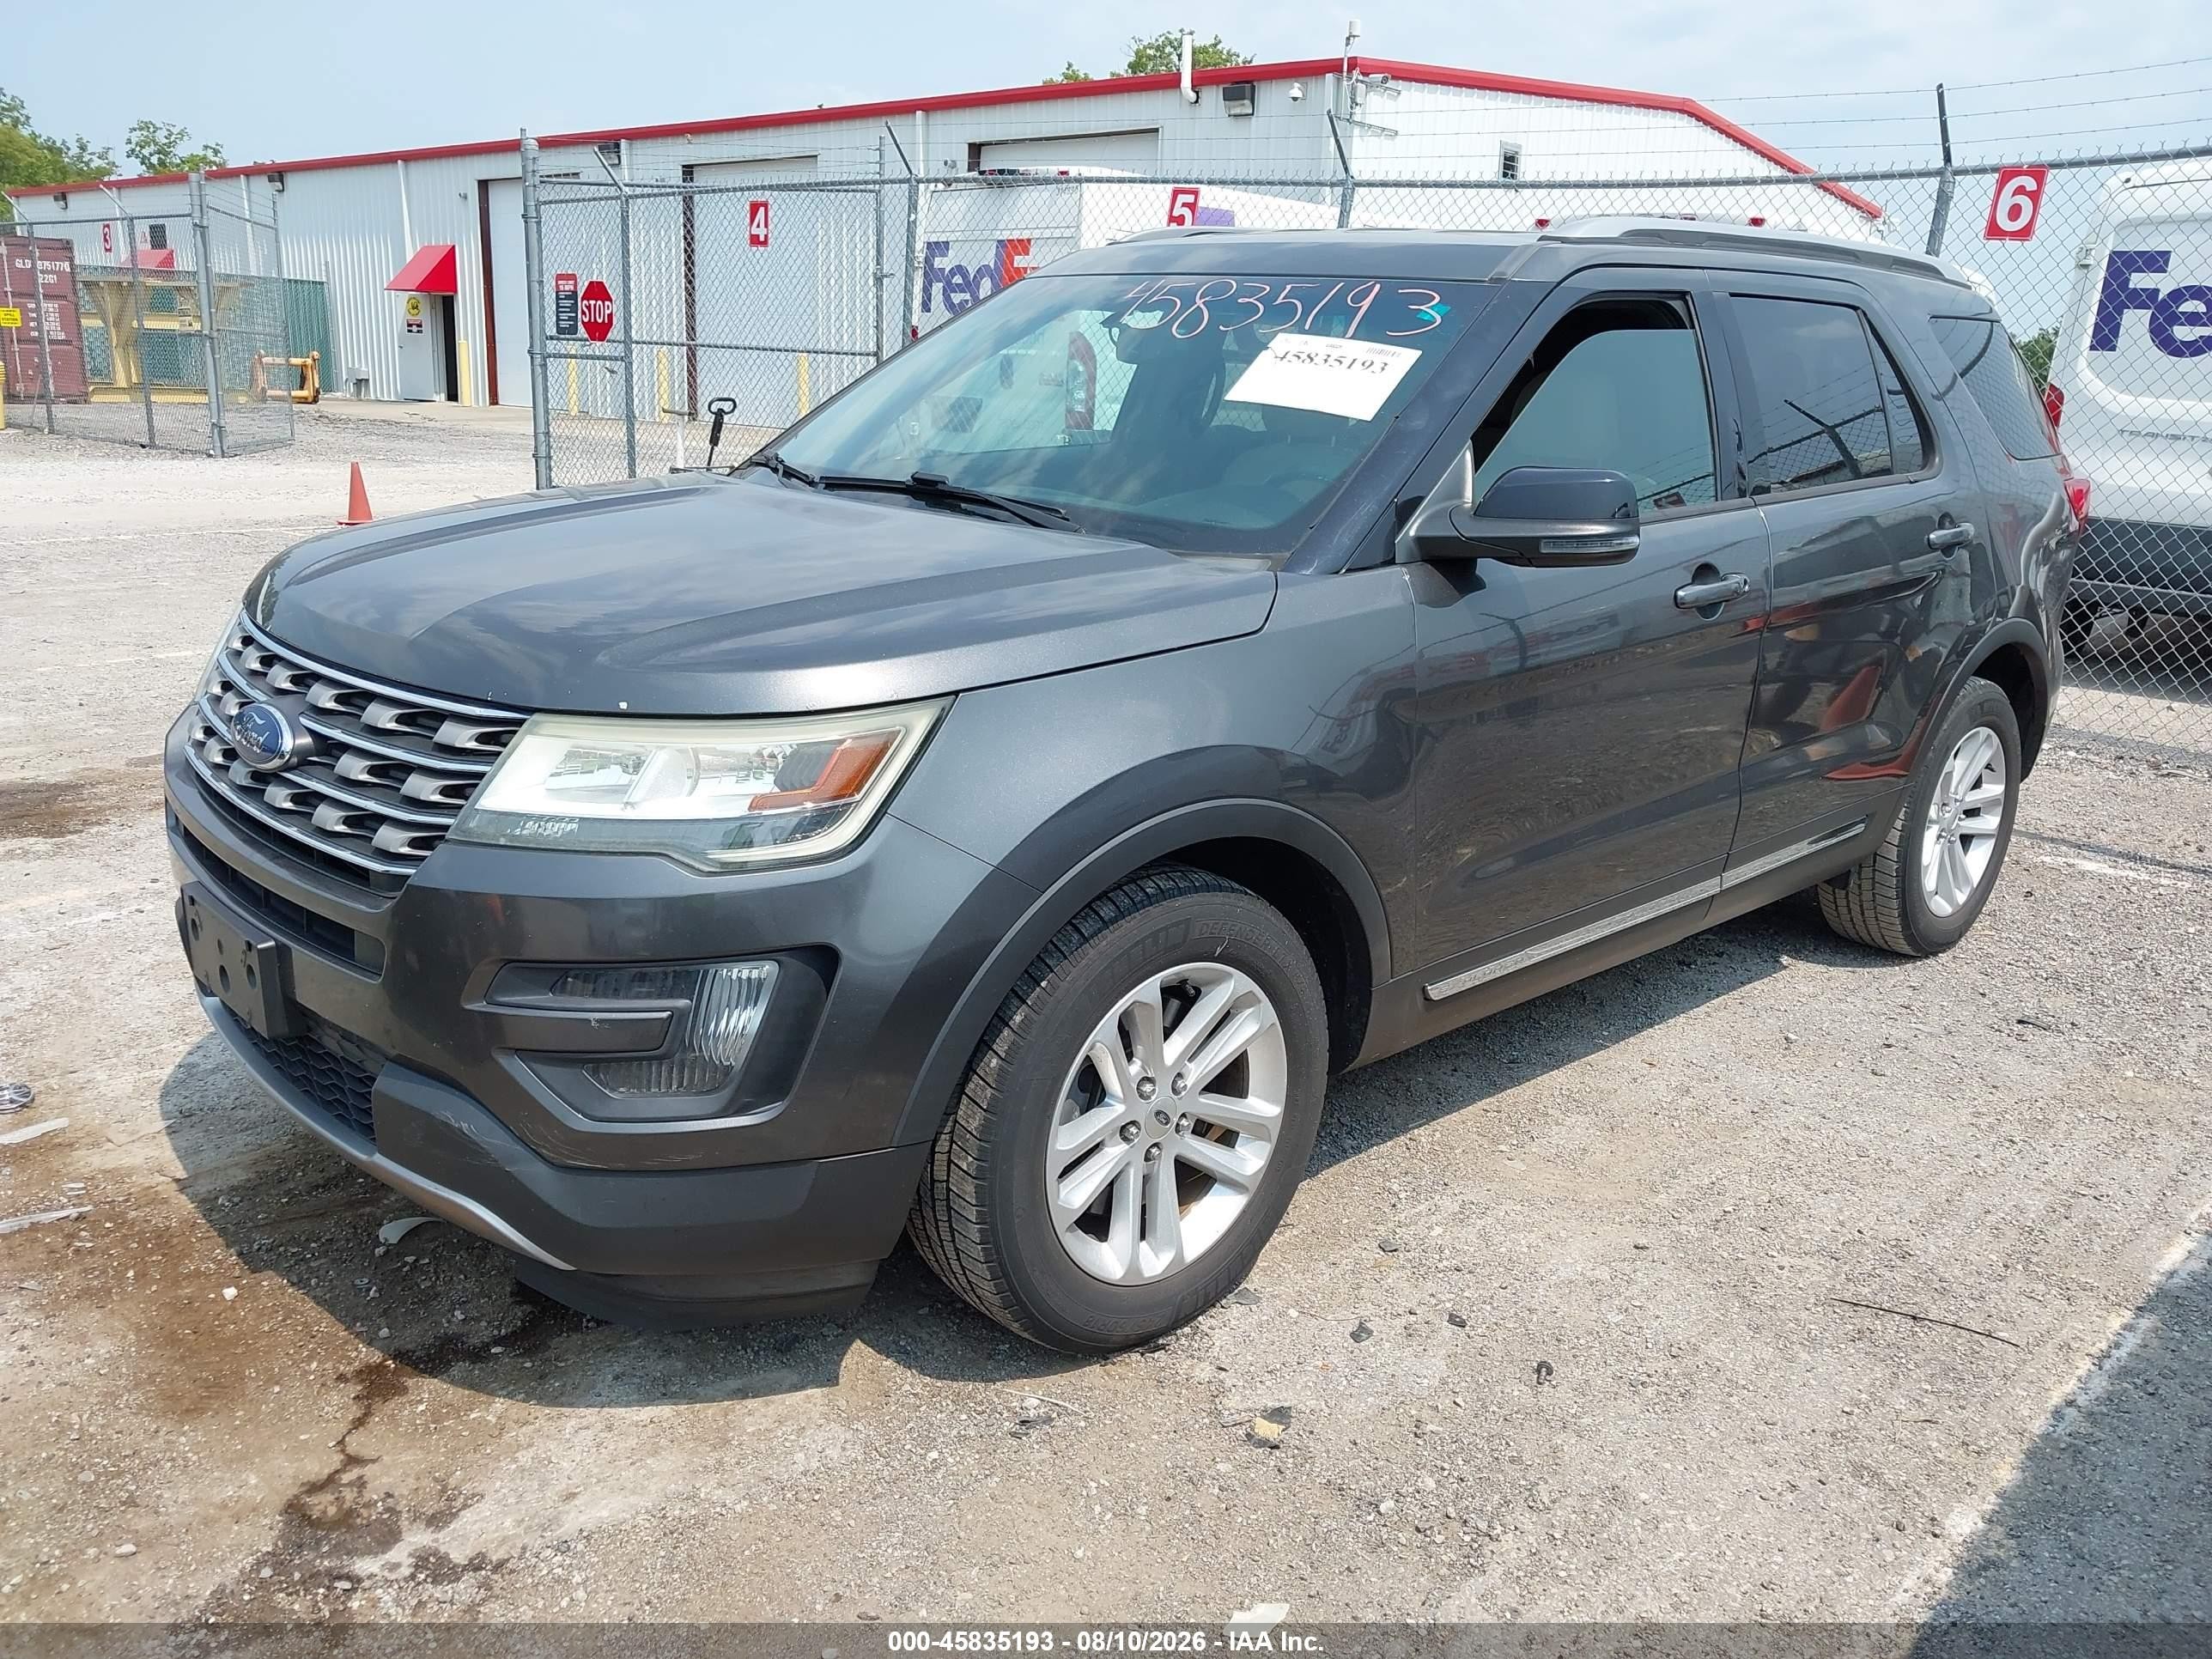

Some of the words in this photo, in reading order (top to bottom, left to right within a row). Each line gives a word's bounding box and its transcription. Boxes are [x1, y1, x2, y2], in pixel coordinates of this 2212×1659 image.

[1170, 194, 1195, 227] 5
[1996, 175, 2038, 232] 6
[104, 226, 112, 250] 3
[751, 206, 768, 241] 4
[921, 238, 1040, 316] FedE
[581, 300, 612, 324] STOP
[1120, 278, 1443, 339] 45835193
[1274, 349, 1389, 374] 45835193
[235, 712, 270, 753] Ford
